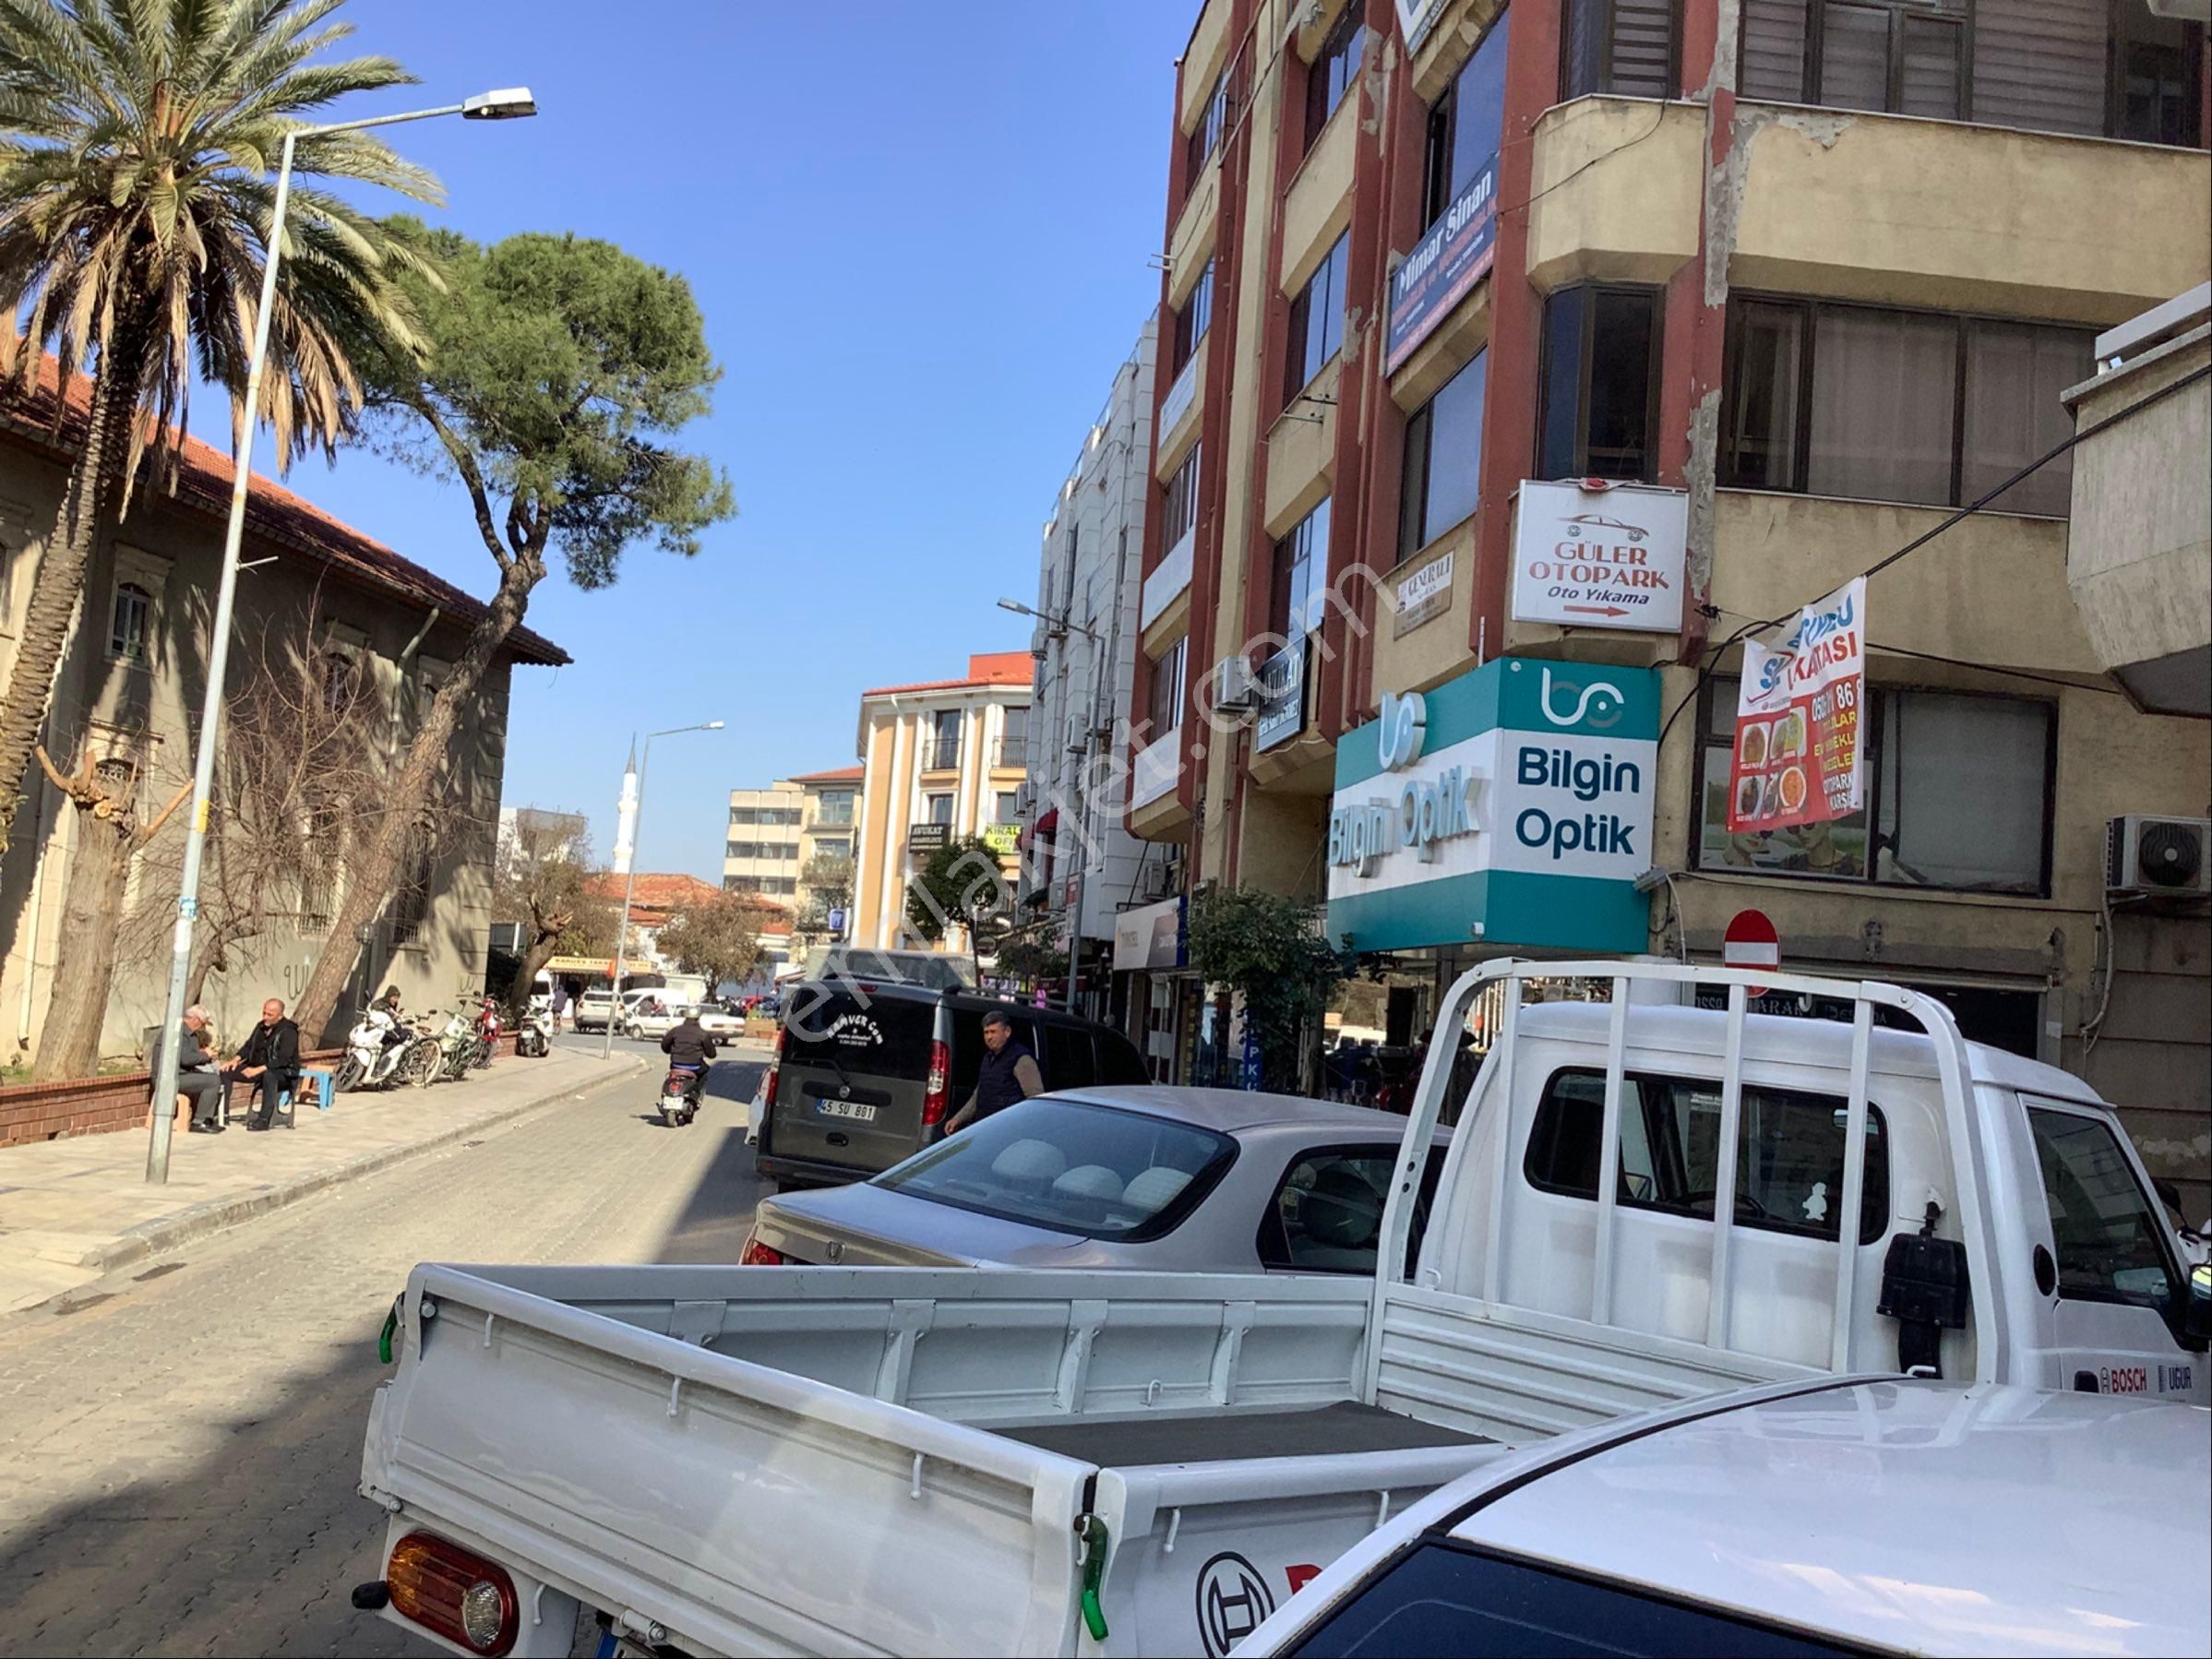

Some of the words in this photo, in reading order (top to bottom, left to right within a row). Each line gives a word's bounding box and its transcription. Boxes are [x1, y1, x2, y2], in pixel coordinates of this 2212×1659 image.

[1398, 228, 1444, 300] Mimar
[1446, 170, 1492, 243] Sinan
[1555, 541, 1647, 566] GÜLER
[1529, 561, 1669, 590] OTOPARK
[1548, 586, 1579, 599] Oto
[1586, 589, 1650, 604] Yıkama
[1517, 746, 1640, 801] Bilgin
[1330, 797, 1392, 877] Bilgin
[1401, 765, 1479, 864] Optik
[1516, 807, 1636, 859] Optik
[820, 1101, 833, 1113] 45
[838, 1104, 851, 1115] SU
[2111, 1367, 2147, 1392] BOSCH
